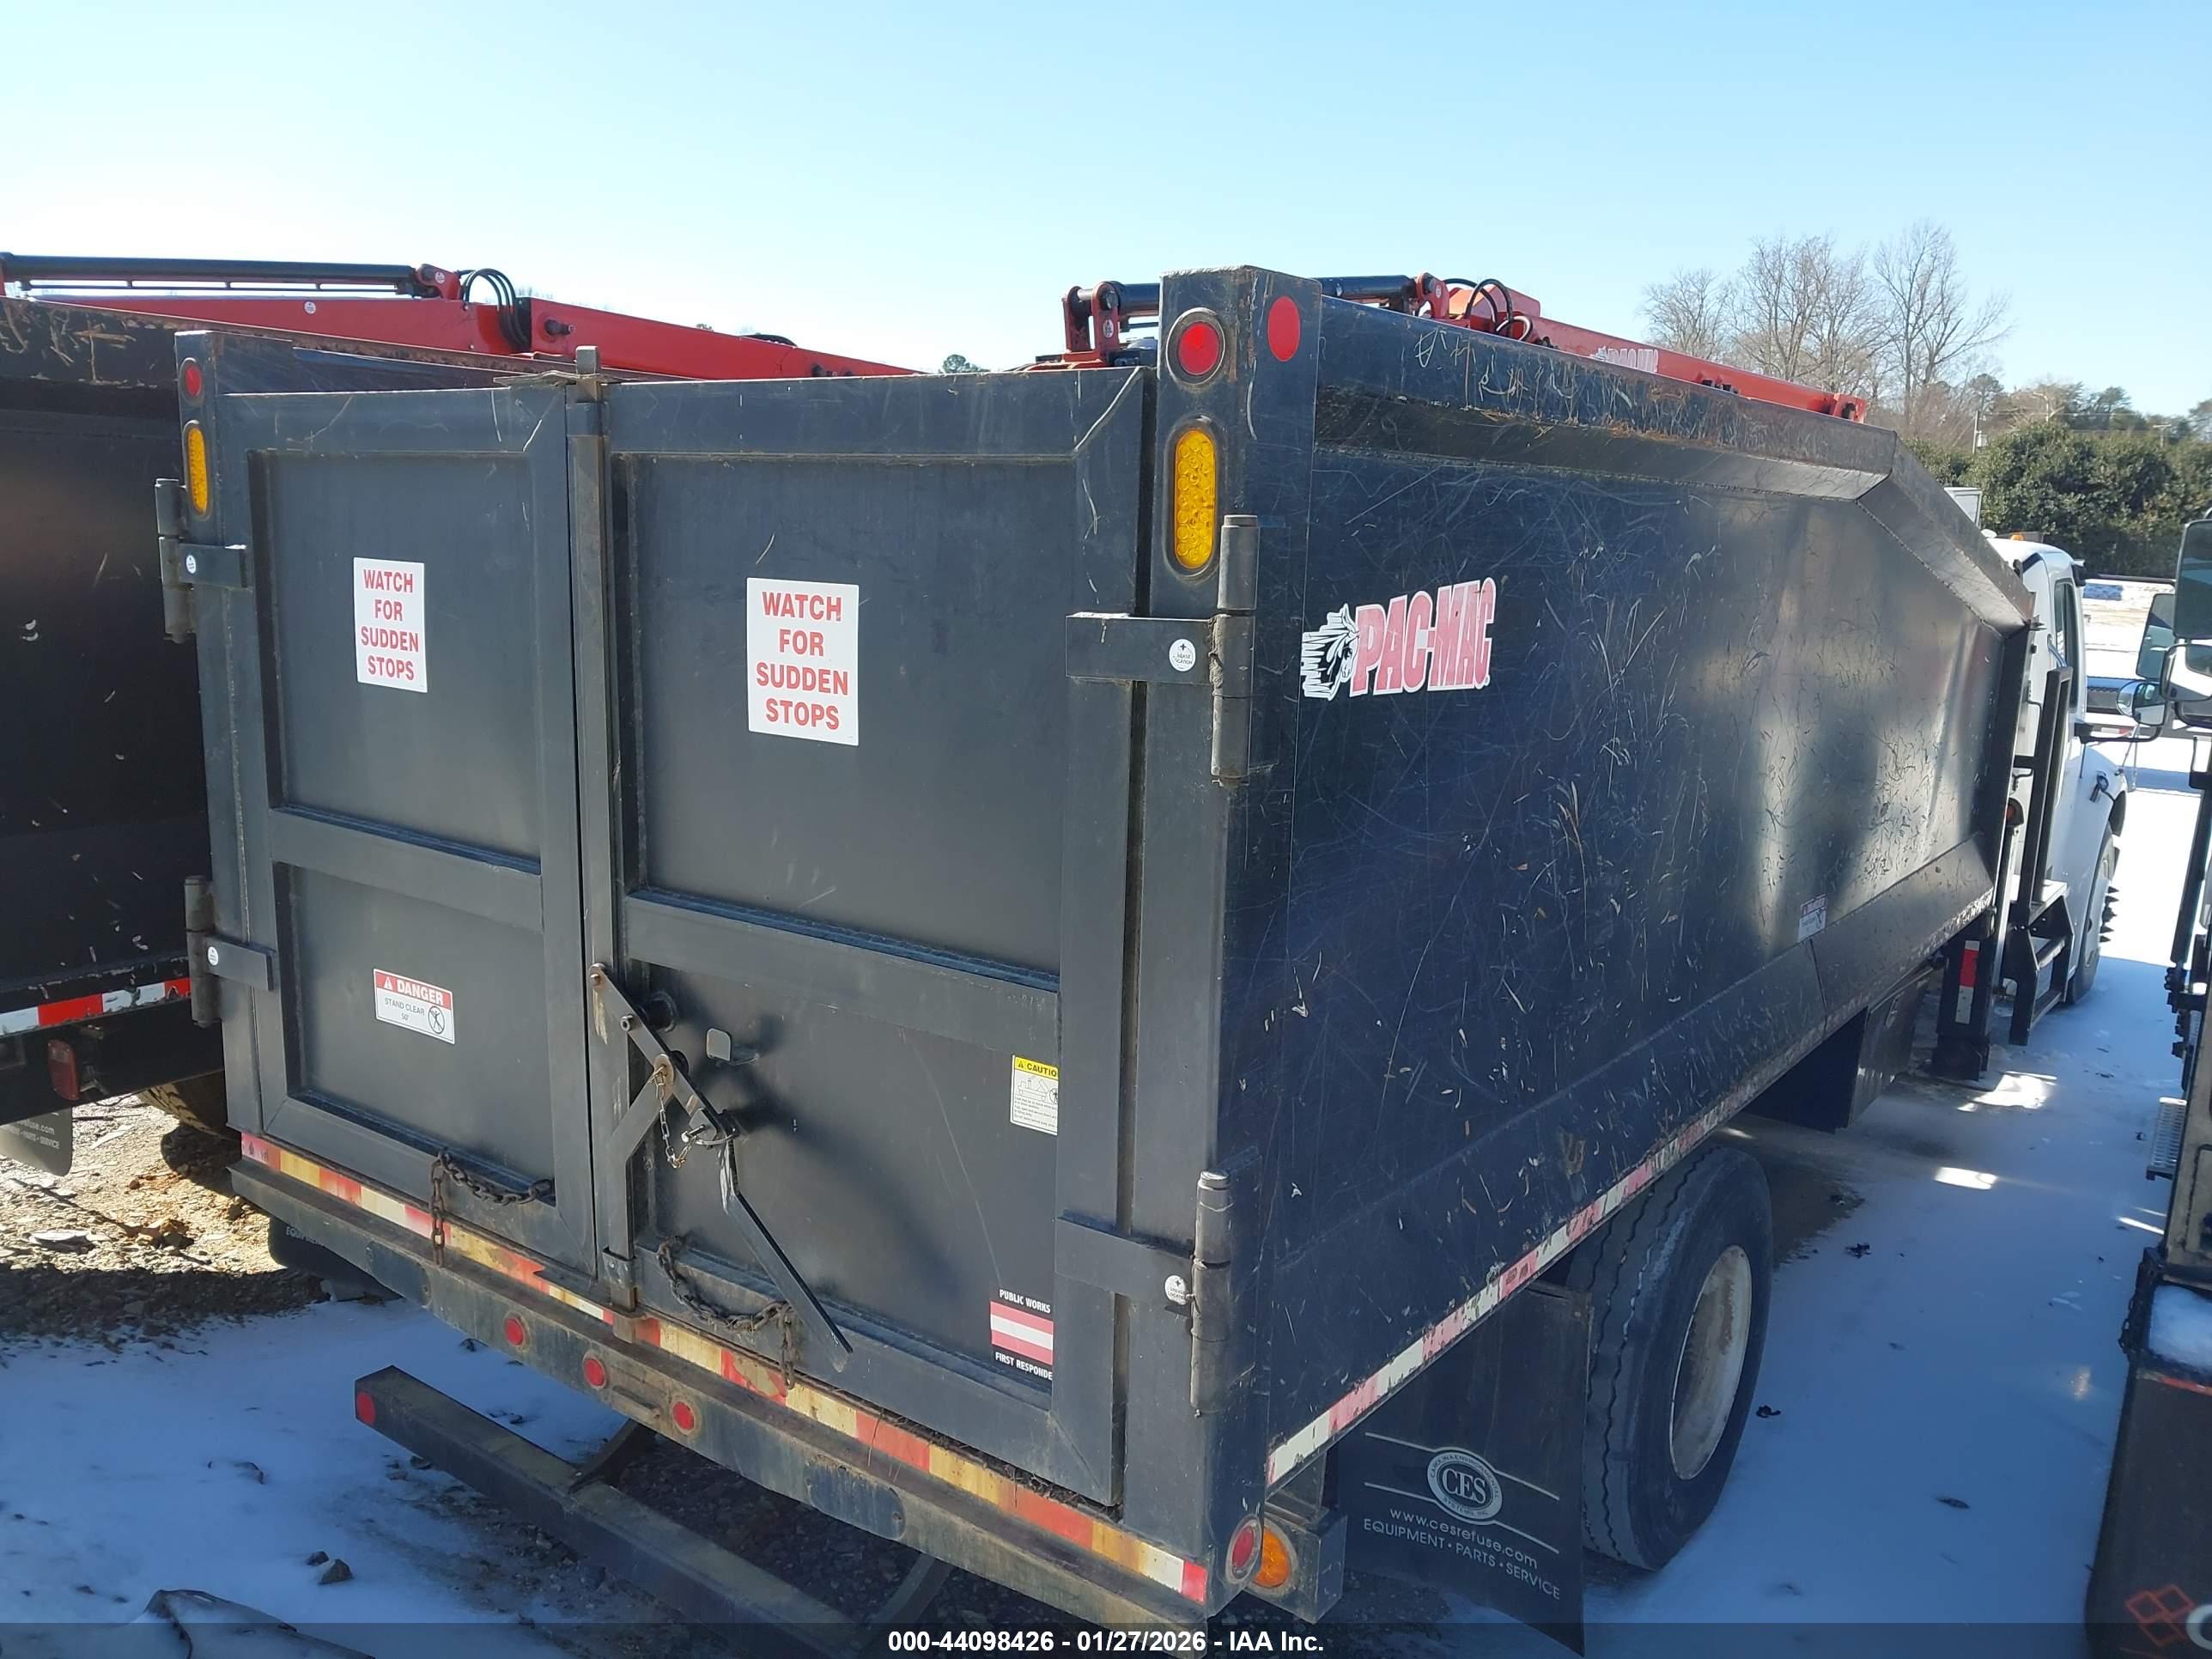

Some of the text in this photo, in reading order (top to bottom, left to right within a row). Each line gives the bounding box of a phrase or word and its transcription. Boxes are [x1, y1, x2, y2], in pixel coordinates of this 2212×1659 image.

[363, 568, 413, 593] WATCH
[374, 599, 403, 621] FOR
[763, 591, 842, 622] WATCH
[361, 626, 419, 653] SUDDEN
[779, 629, 824, 657] FOR
[1349, 577, 1497, 697] PAC-MAC
[368, 655, 414, 681] STOPS
[756, 661, 848, 696] SUDDEN
[766, 697, 840, 730] STOPS
[397, 979, 443, 1006] DANGER
[385, 997, 425, 1017] STAND CLEAR
[1026, 1063, 1057, 1077] CAUTIO
[1000, 1289, 1051, 1314] PUBLIC WORKS
[995, 1352, 1053, 1381] FIRST RESPONDE
[1443, 1468, 1486, 1504] CES
[1389, 1508, 1538, 1570] www.cesrefuse.com
[1364, 1517, 1560, 1601] EQUIPMENT PARTS SERVICE
